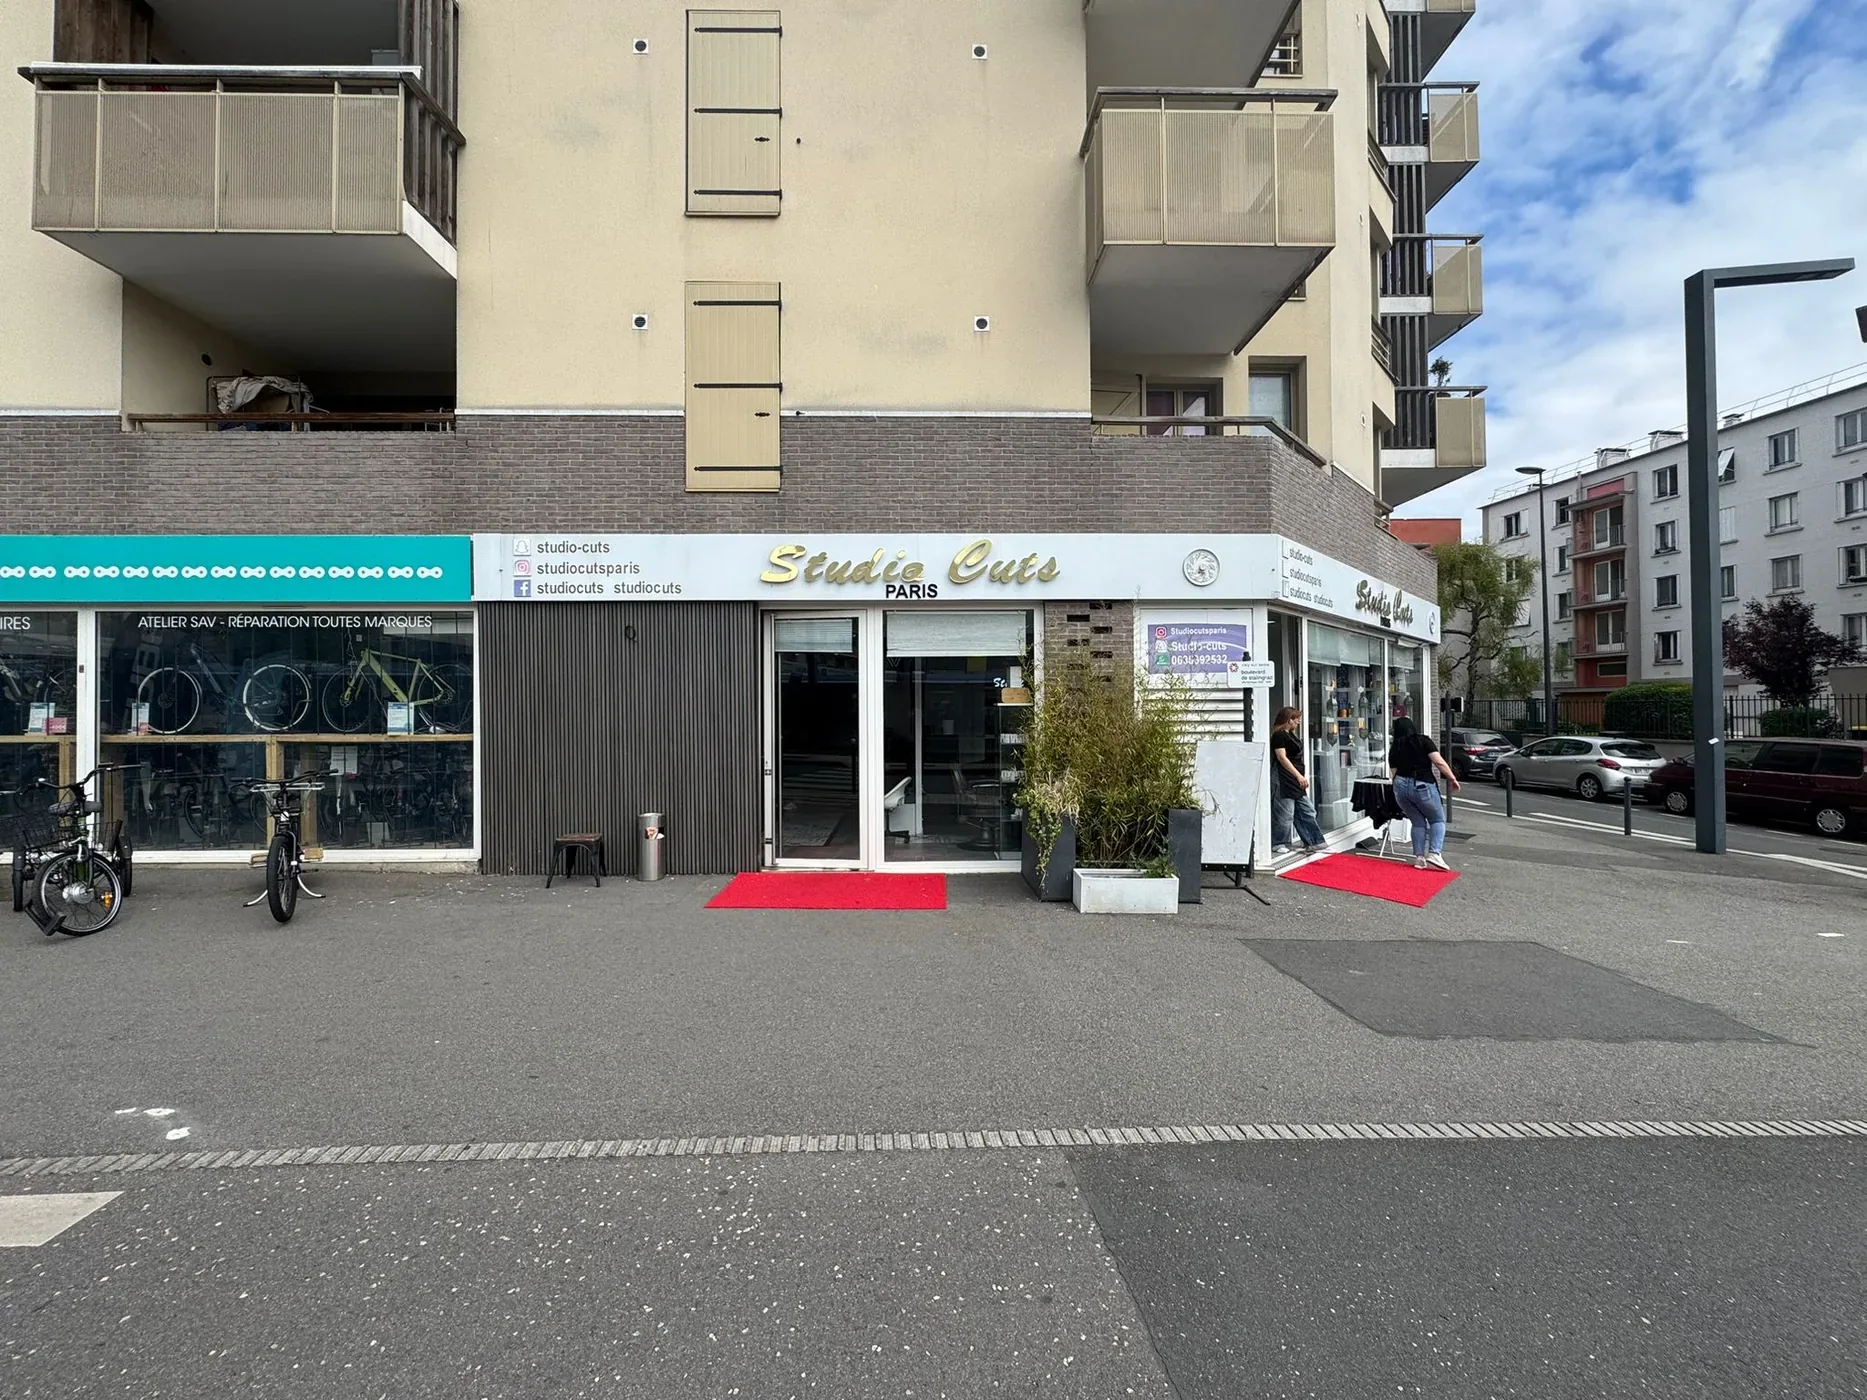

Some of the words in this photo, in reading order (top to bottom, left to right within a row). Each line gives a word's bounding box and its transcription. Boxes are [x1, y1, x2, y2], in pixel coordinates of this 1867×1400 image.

[537, 540, 610, 554] studio-cuts
[537, 561, 640, 577] studiocutsparis
[759, 544, 927, 584] Studio
[949, 539, 1061, 584] Cuts
[537, 581, 604, 594] studiocuts
[613, 581, 682, 594] studiocuts
[885, 583, 938, 599] PARIS
[138, 616, 187, 628] ATELIER
[190, 616, 217, 628] SAV
[228, 613, 310, 628] RÉPARATION
[312, 615, 361, 628] TOUTES
[364, 615, 432, 628] MARQUES
[1170, 627, 1227, 636] Studiocutsparis
